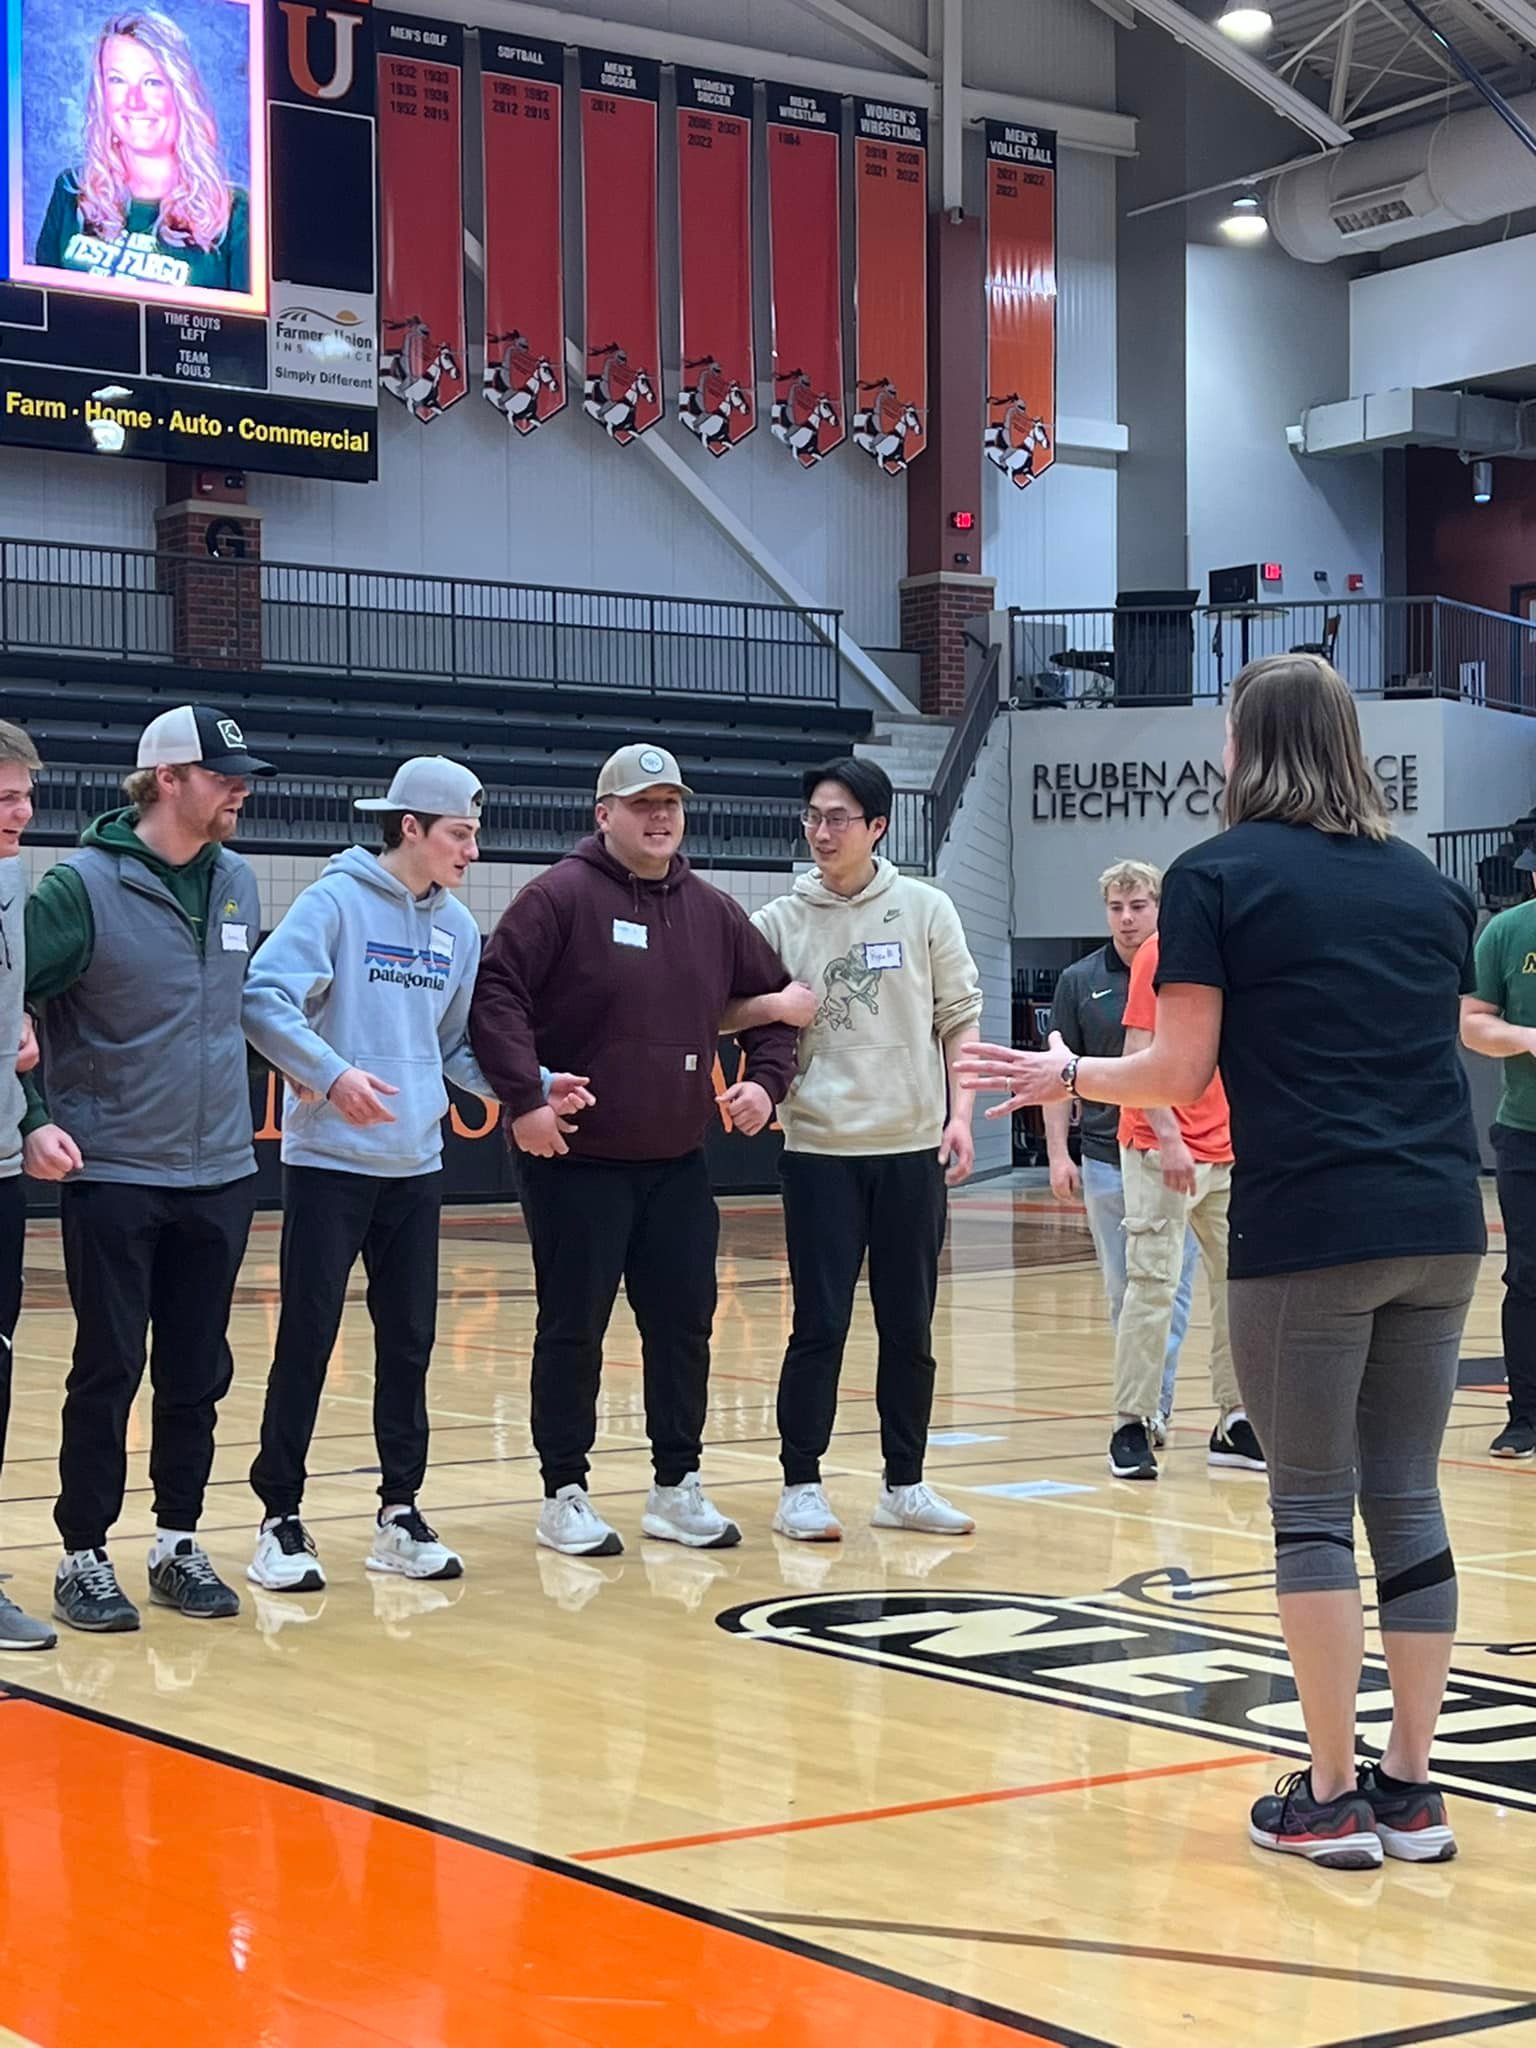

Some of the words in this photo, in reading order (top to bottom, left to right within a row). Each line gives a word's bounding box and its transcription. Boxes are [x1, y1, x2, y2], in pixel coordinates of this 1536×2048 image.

[391, 25, 421, 42] MEN'S
[423, 31, 448, 47] GOLF
[497, 45, 544, 65] SOFTBALL
[604, 61, 632, 77] MEN'S
[601, 73, 637, 90] SOCCER
[693, 78, 735, 97] WOMEN'S
[697, 91, 731, 107] SOCCER
[790, 95, 816, 110] MEN'S
[779, 105, 826, 124] WRESTLING
[865, 103, 917, 125] WOMEN'S
[860, 118, 921, 142] WRESTLING
[1005, 127, 1038, 146] MEN'S
[990, 140, 1053, 164] VOLLEYBALL
[164, 312, 190, 326] TIME
[192, 316, 221, 330] OUTS
[181, 328, 206, 342] LEFT
[276, 321, 327, 342] Farmer
[179, 350, 209, 364] TEAM
[176, 362, 211, 378] FOULS
[275, 366, 317, 385] Simply
[320, 371, 372, 389] Different
[6, 391, 66, 419] Farm
[85, 400, 152, 428] Home
[169, 410, 222, 436] Auto
[239, 418, 369, 452] Commercial
[1033, 760, 1166, 790] REUBEN
[1032, 789, 1177, 820] LIECHTY
[369, 968, 445, 991] patagonia
